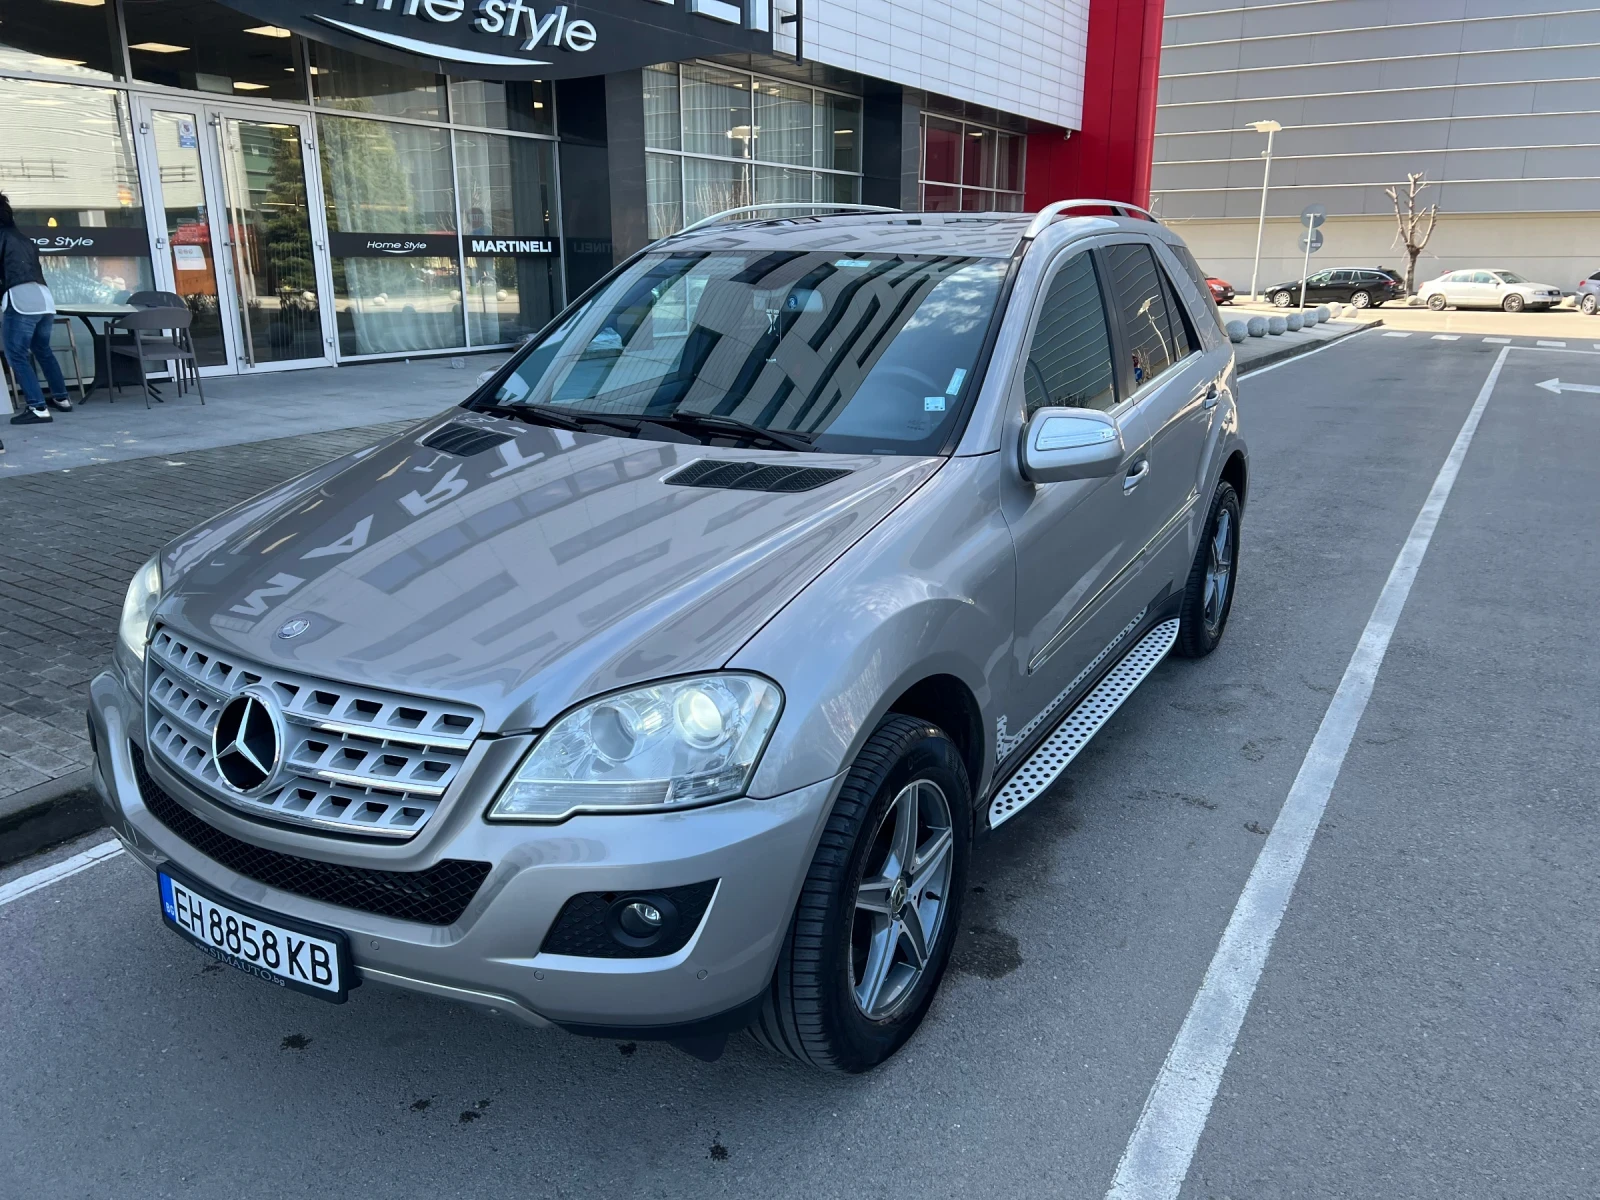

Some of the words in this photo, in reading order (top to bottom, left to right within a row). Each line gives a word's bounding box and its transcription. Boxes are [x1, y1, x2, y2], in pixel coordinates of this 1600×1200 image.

[54, 236, 94, 248] Style
[366, 240, 402, 250] Home
[403, 241, 427, 252] Style
[471, 239, 552, 253] MARTINELI
[165, 901, 175, 916] BG
[174, 886, 205, 938] EH
[209, 907, 281, 969] 8858
[286, 936, 333, 986] KB
